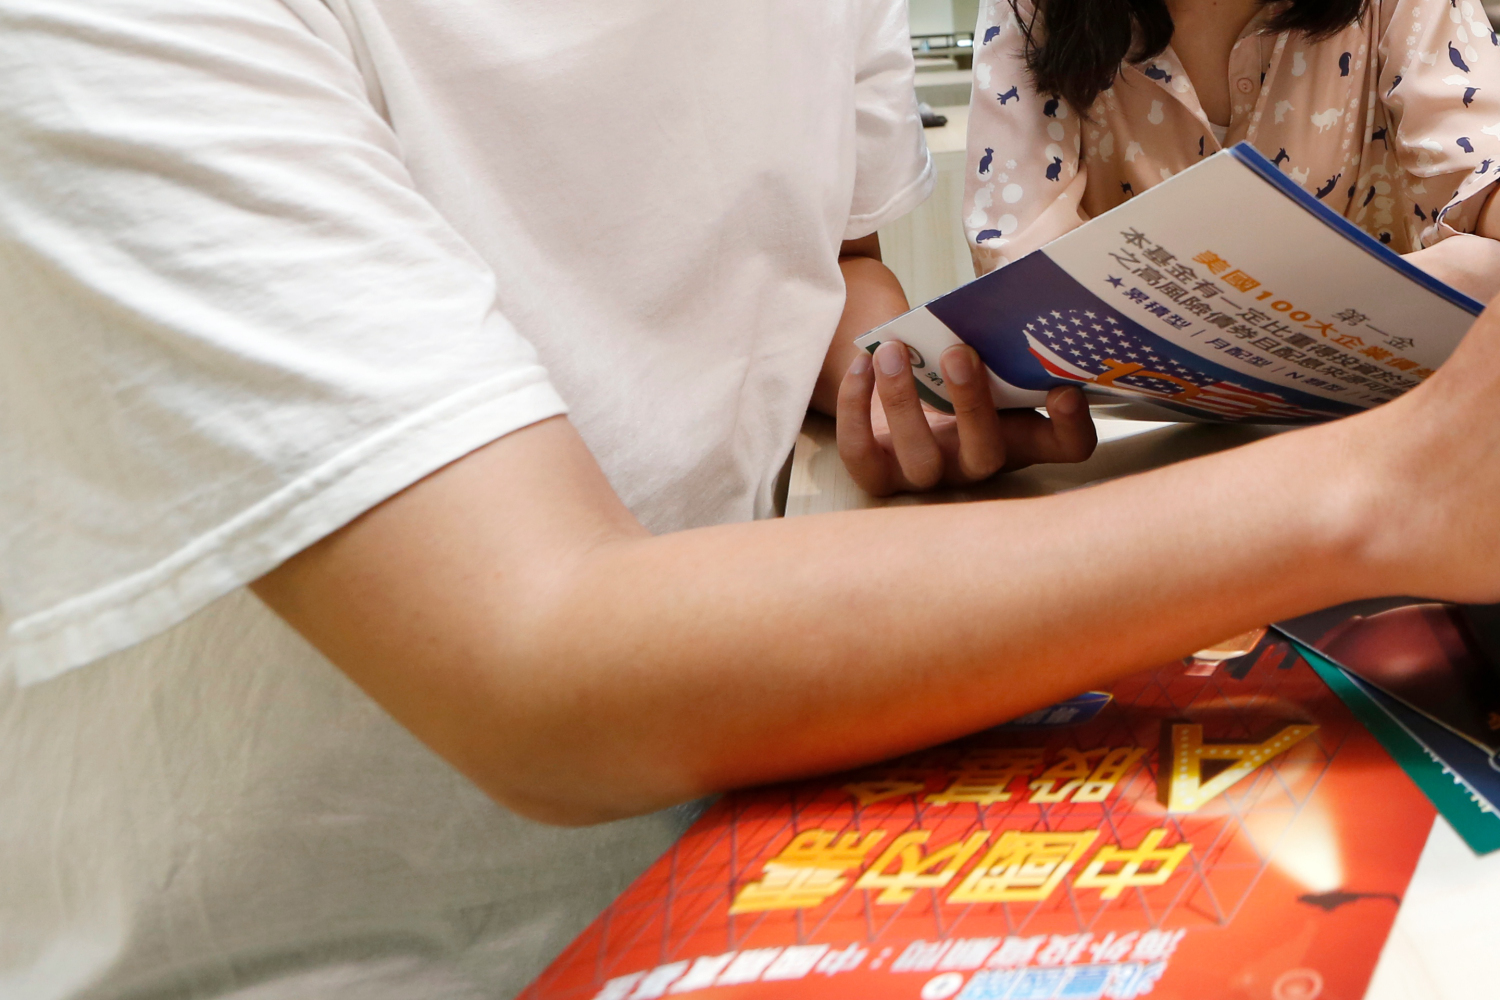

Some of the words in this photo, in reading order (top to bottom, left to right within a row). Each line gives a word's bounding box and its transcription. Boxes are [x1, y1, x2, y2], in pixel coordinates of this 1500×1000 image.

[1121, 287, 1193, 331] 累積型
[1203, 336, 1273, 368] 月配型
[1331, 307, 1416, 351] 第一金
[727, 827, 1193, 917] 中國內需
